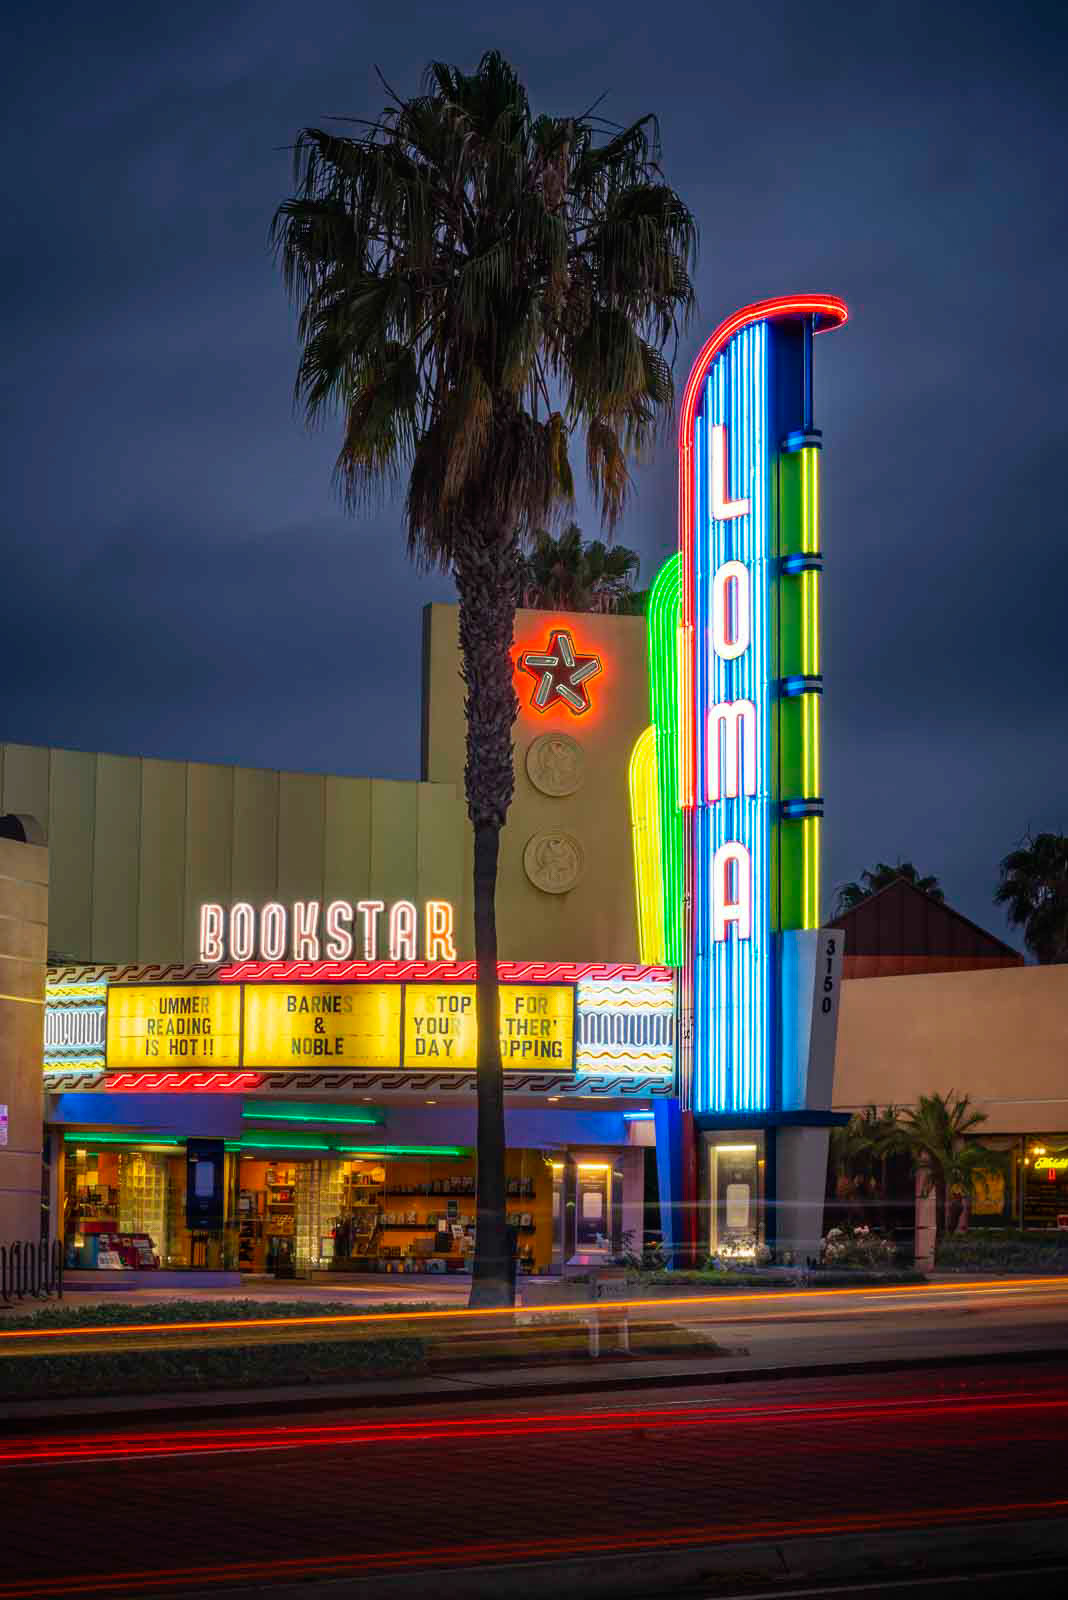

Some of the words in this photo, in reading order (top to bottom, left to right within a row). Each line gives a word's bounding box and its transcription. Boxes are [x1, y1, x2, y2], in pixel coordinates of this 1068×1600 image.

[708, 424, 756, 942] LOMA
[199, 898, 457, 963] BOOKSTAR
[822, 939, 836, 1013] 3150
[287, 995, 353, 1013] BARNES
[514, 996, 548, 1014] FOR
[147, 1017, 211, 1036] READING
[314, 1017, 325, 1034] &
[145, 1039, 159, 1056] IS
[291, 1037, 344, 1056] NOBLE
[415, 1038, 454, 1057] DAY
